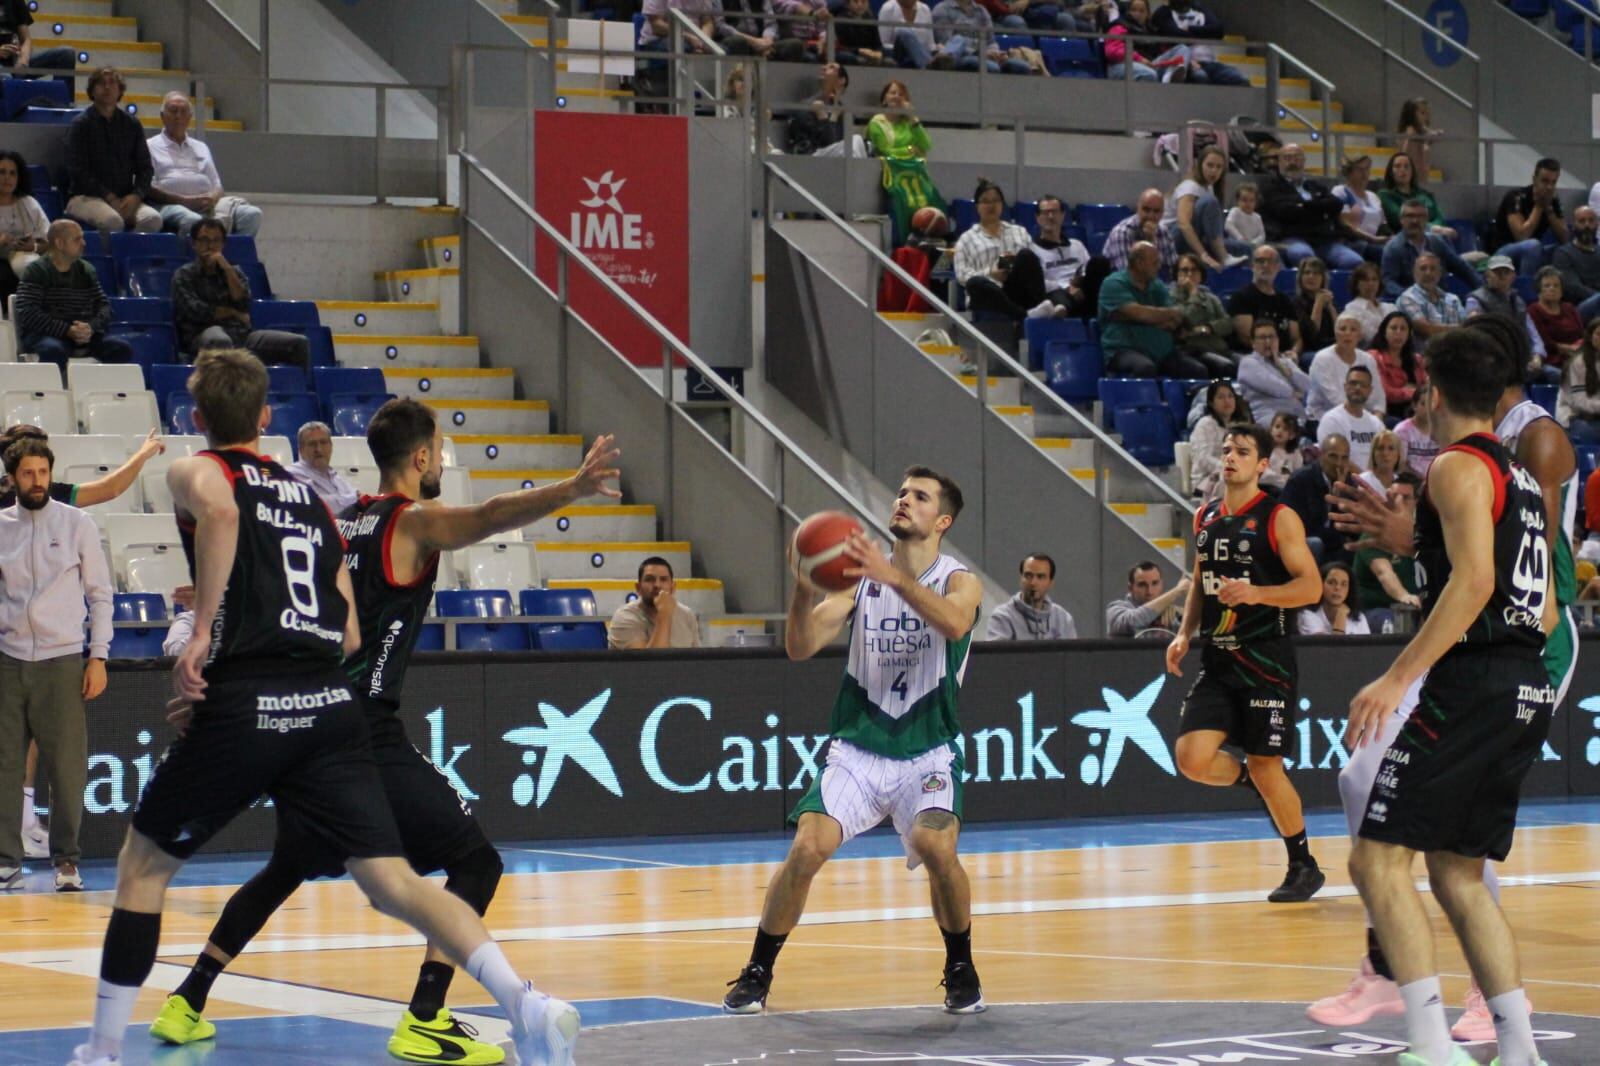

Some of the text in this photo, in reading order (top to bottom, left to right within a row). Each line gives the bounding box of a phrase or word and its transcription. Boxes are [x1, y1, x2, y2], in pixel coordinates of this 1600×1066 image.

[571, 212, 642, 249] IME
[1214, 538, 1230, 561] 15
[281, 536, 319, 618] 8
[890, 671, 908, 701] 4
[256, 687, 352, 711] motorisa
[256, 714, 316, 733] lloguer
[1376, 773, 1399, 788] IME
